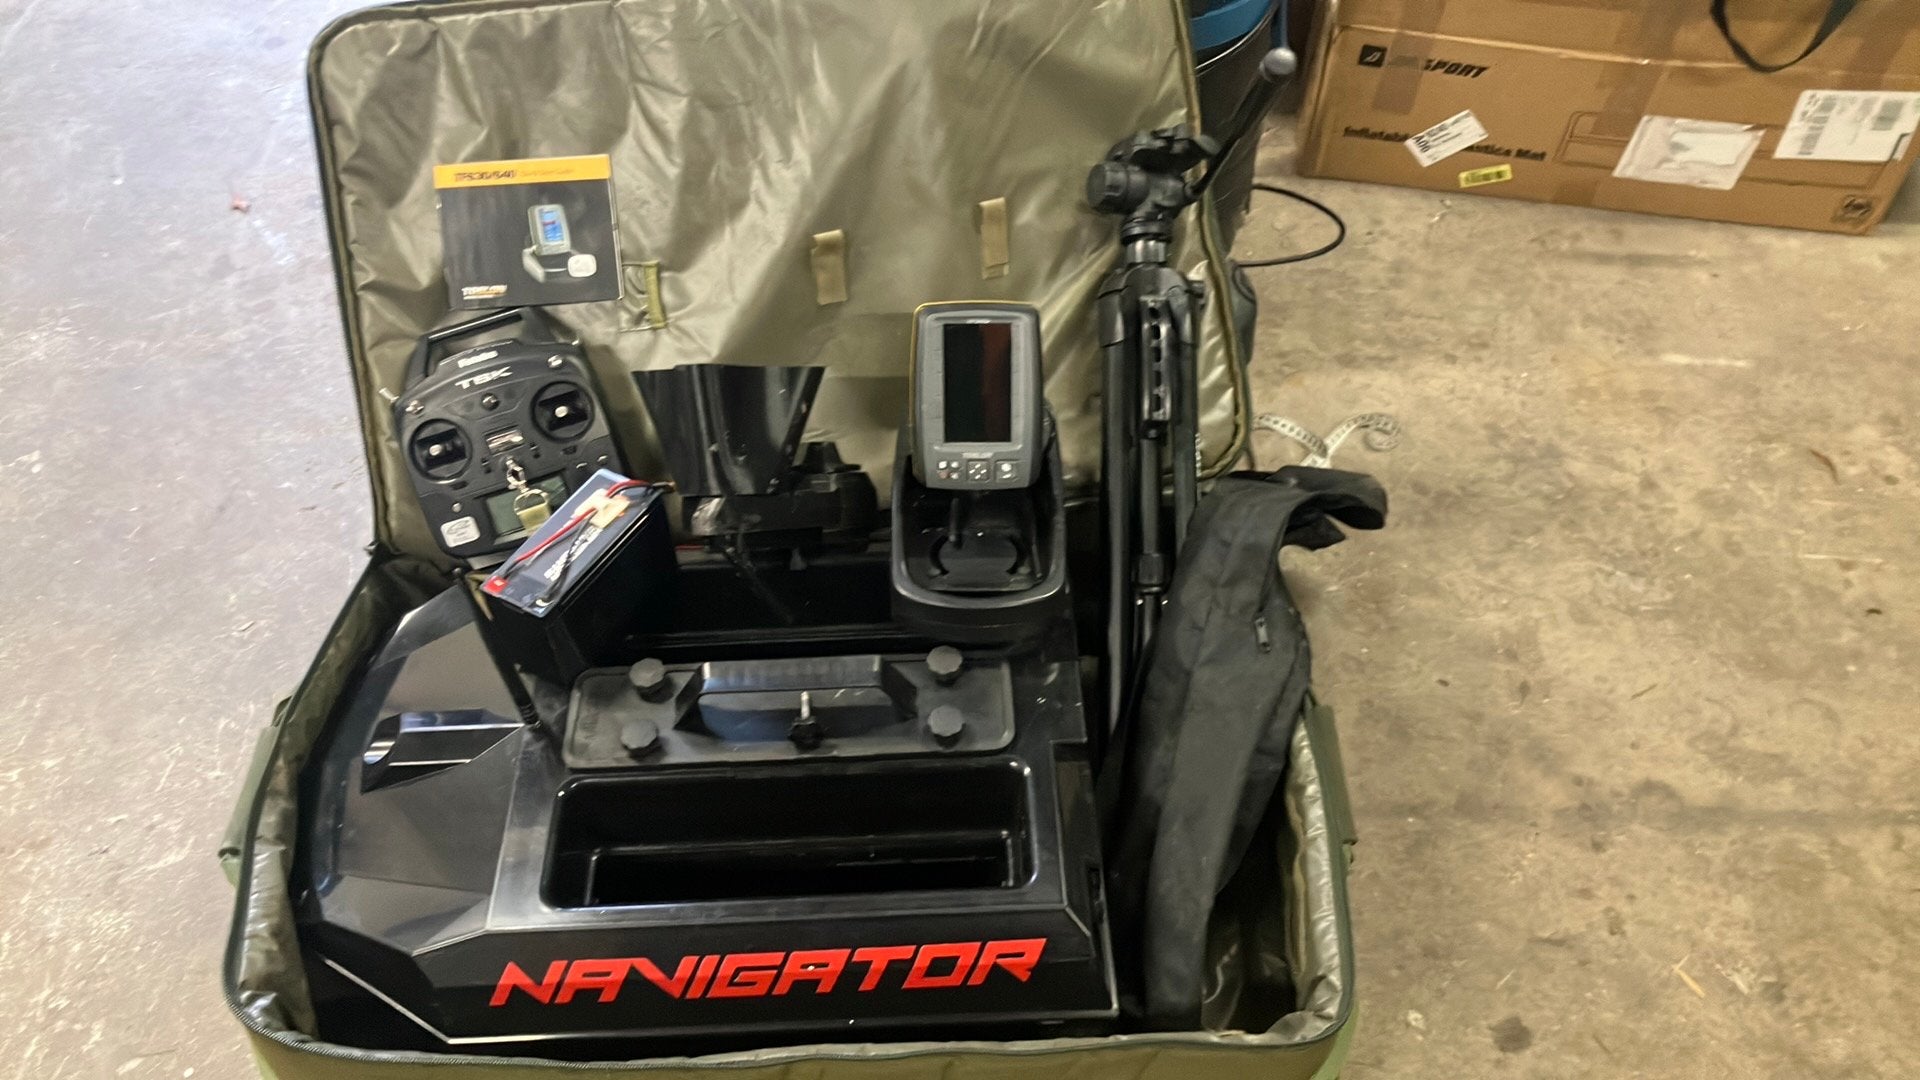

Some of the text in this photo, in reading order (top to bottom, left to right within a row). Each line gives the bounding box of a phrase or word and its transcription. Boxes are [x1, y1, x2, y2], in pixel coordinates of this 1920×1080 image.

[1343, 126, 1411, 143] Inflatabl
[1515, 148, 1547, 161] Mat
[489, 938, 1047, 1006] NAVIGATOR
